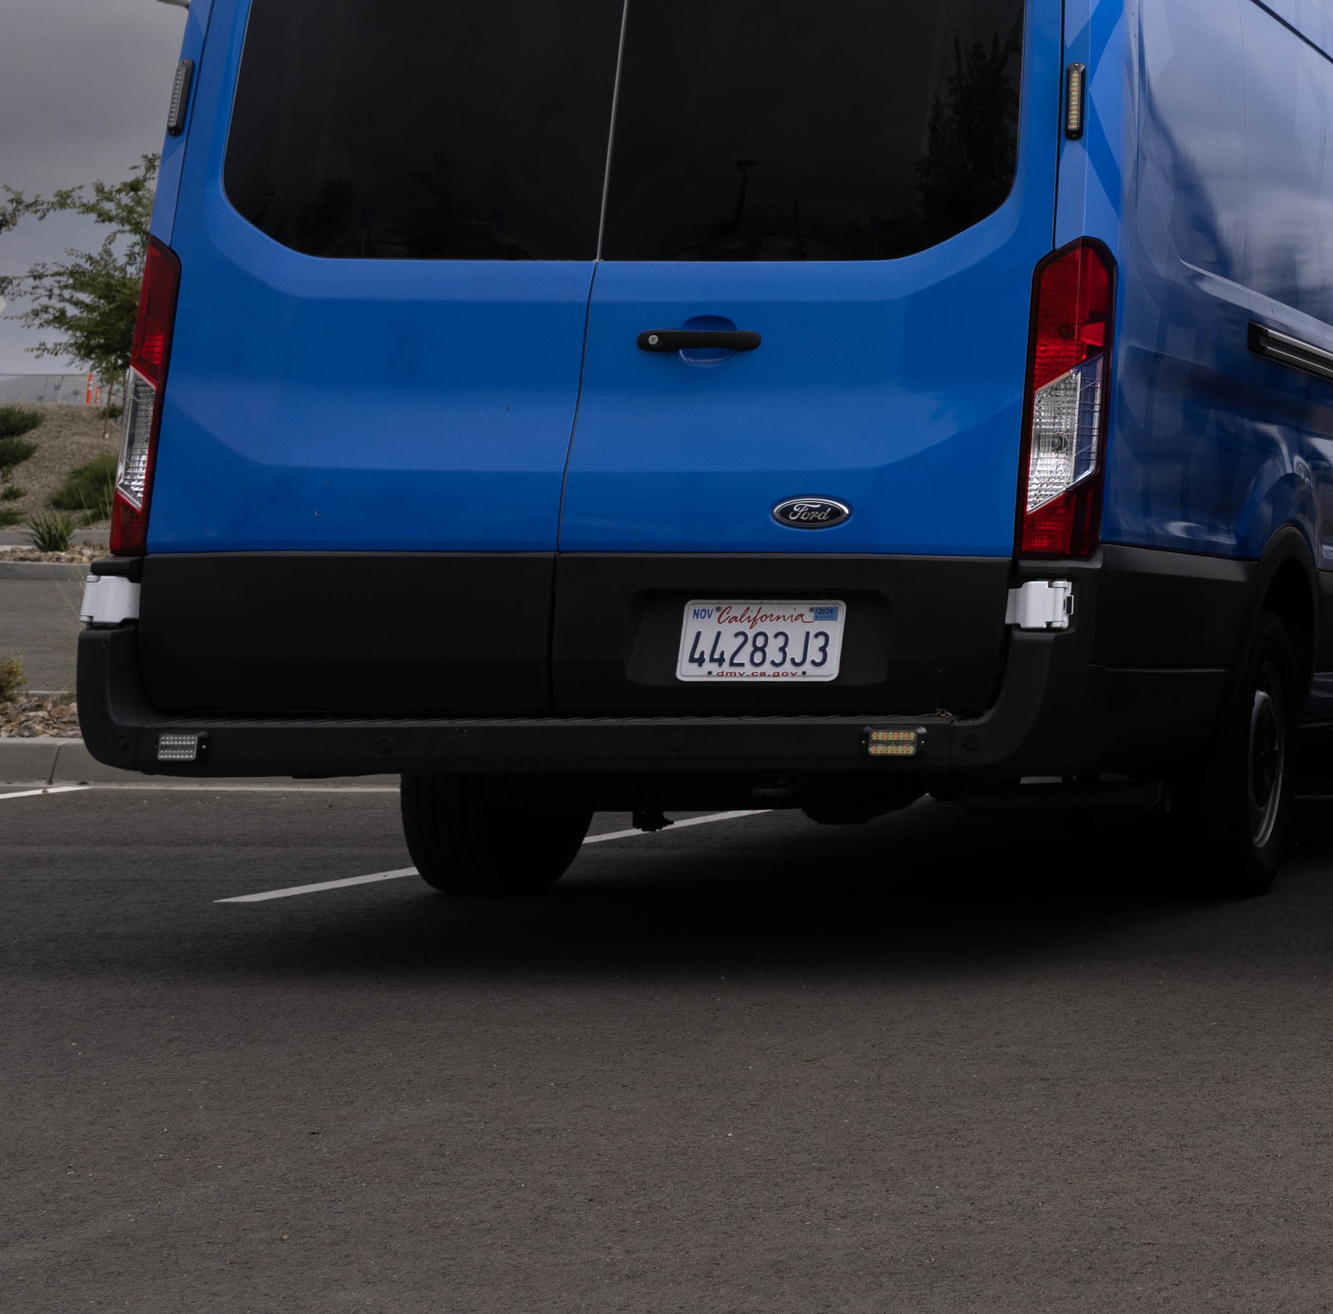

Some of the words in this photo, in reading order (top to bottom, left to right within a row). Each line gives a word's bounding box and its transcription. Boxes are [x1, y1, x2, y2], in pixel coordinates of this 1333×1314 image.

[788, 503, 832, 520] Ford
[692, 608, 714, 620] NOV
[717, 606, 815, 629] California
[688, 630, 830, 667] 44283J3
